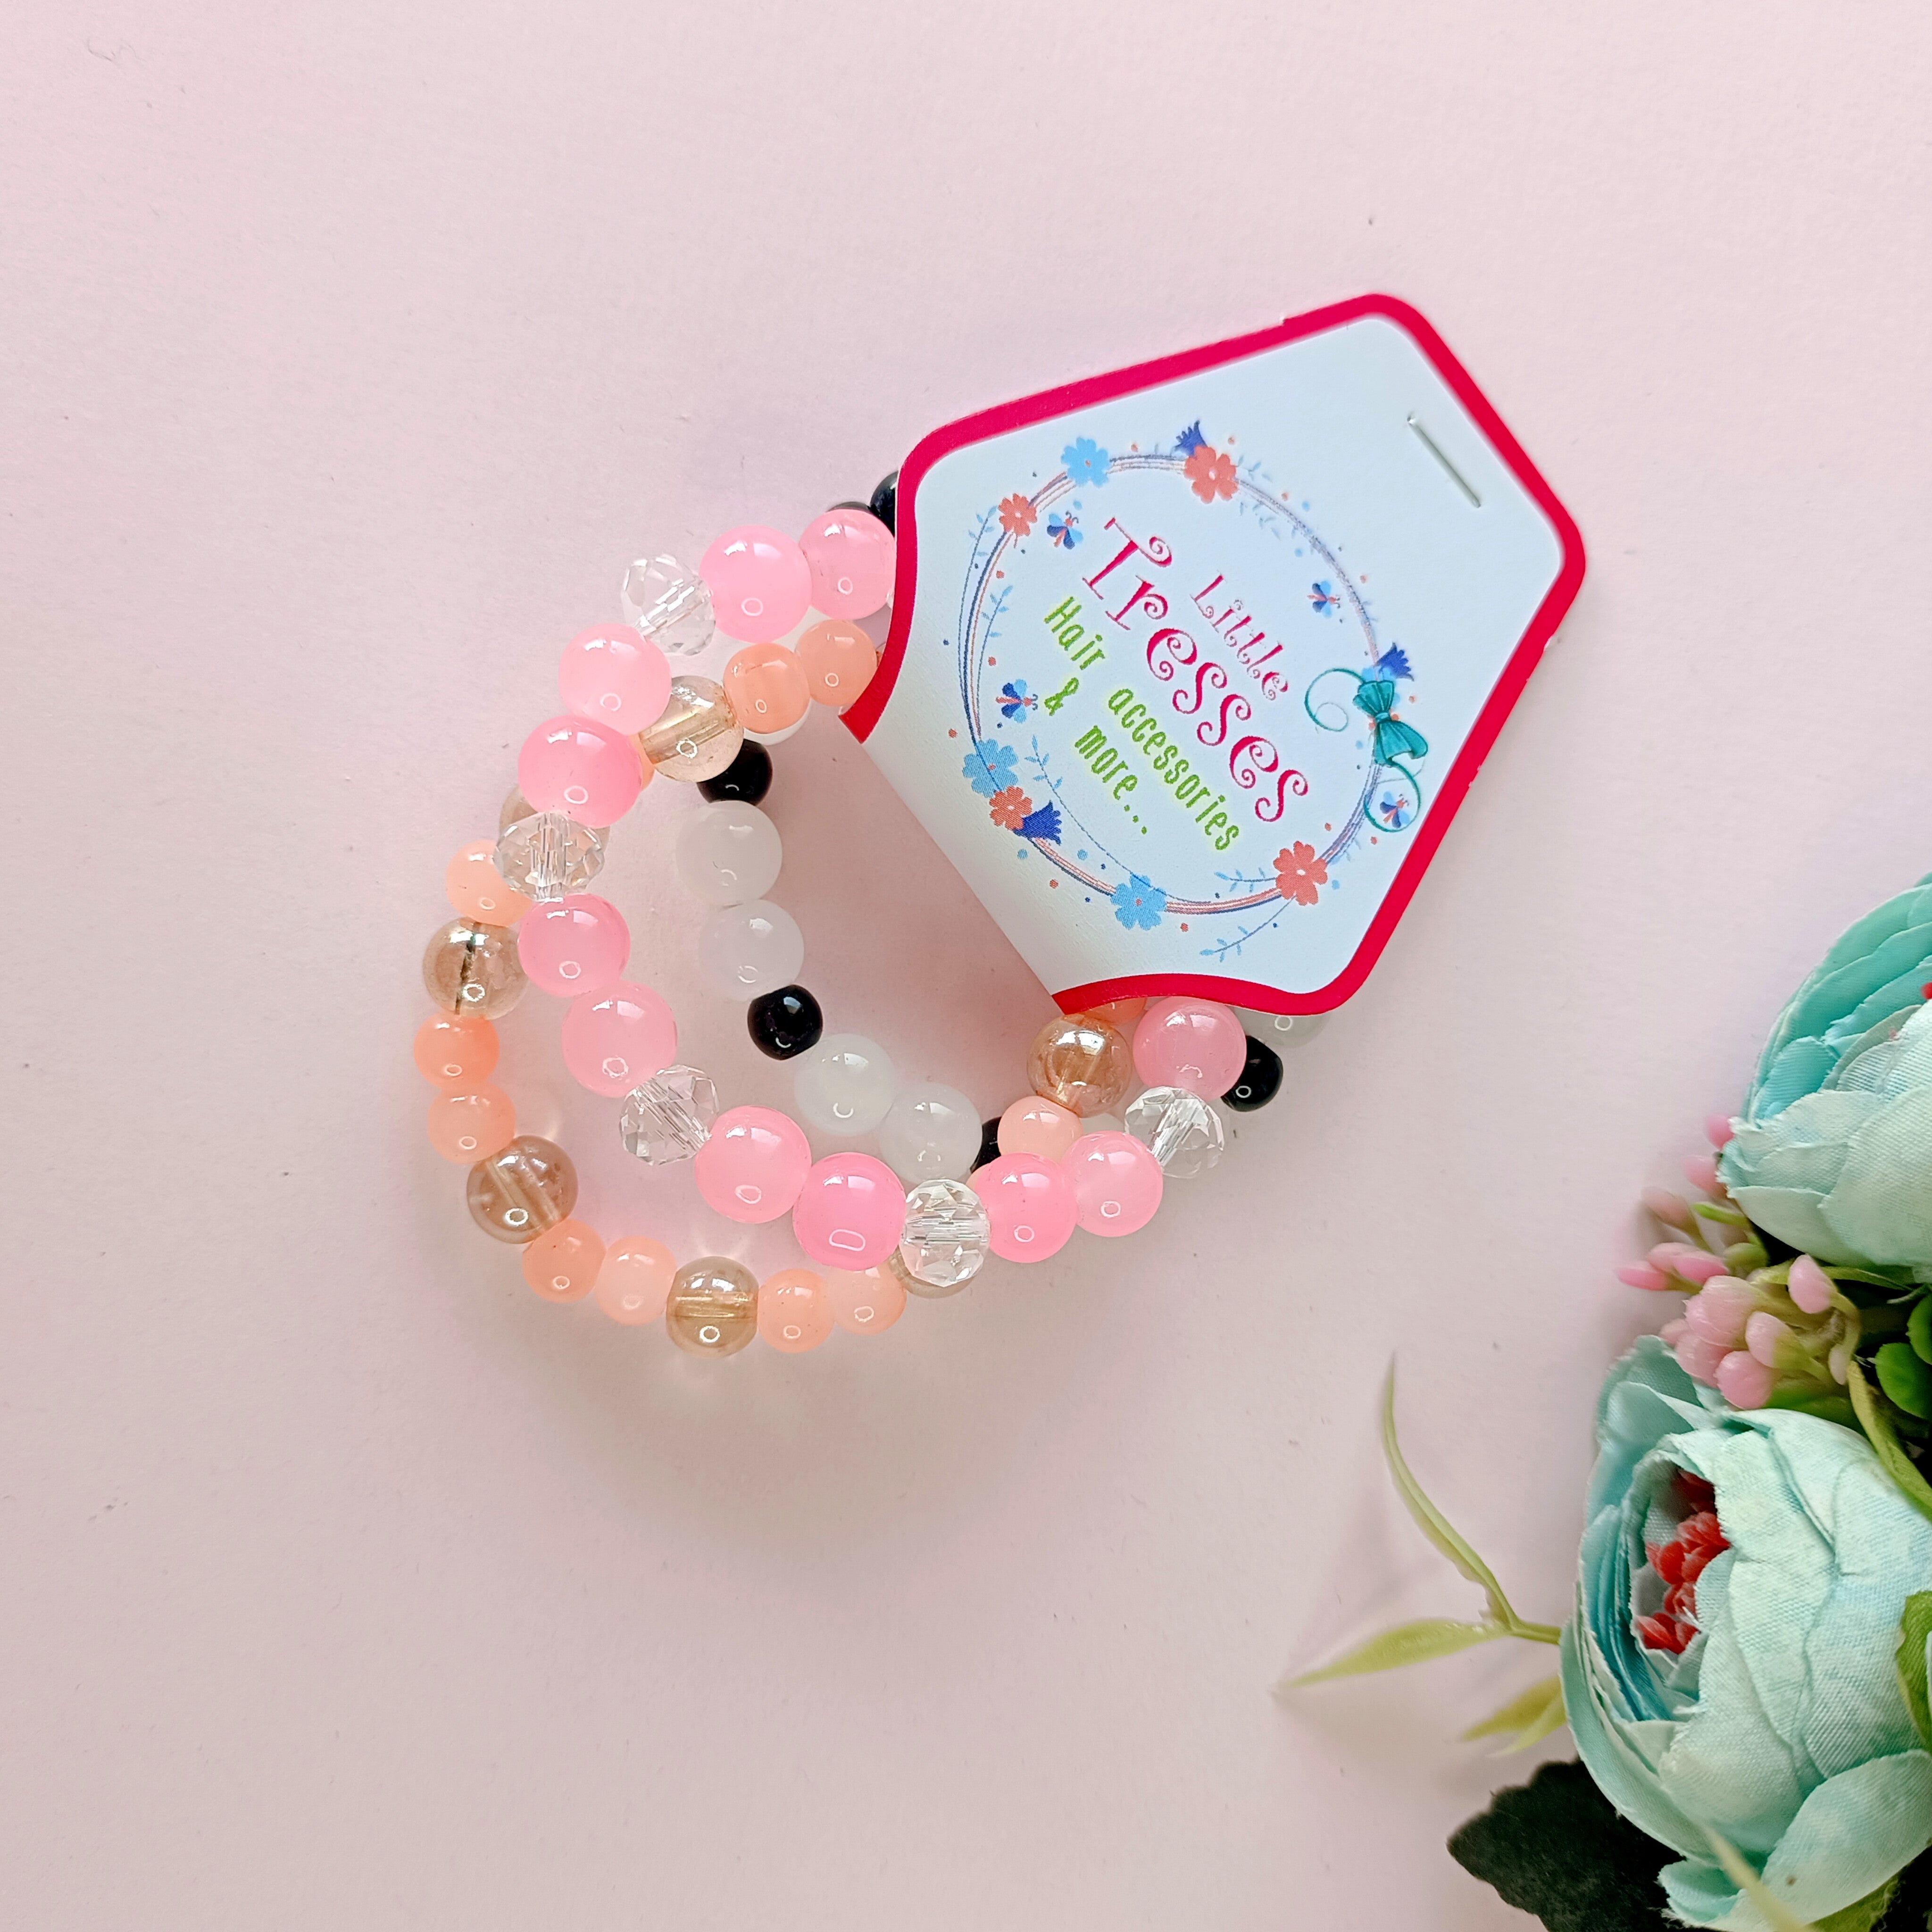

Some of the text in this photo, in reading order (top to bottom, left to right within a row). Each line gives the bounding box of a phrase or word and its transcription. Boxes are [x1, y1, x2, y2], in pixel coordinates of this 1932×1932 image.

[1044, 596, 1240, 850] Hair accessories
[1082, 517, 1308, 822] Tresses
[1190, 570, 1288, 700] Little
[1044, 677, 1148, 835] & more...
